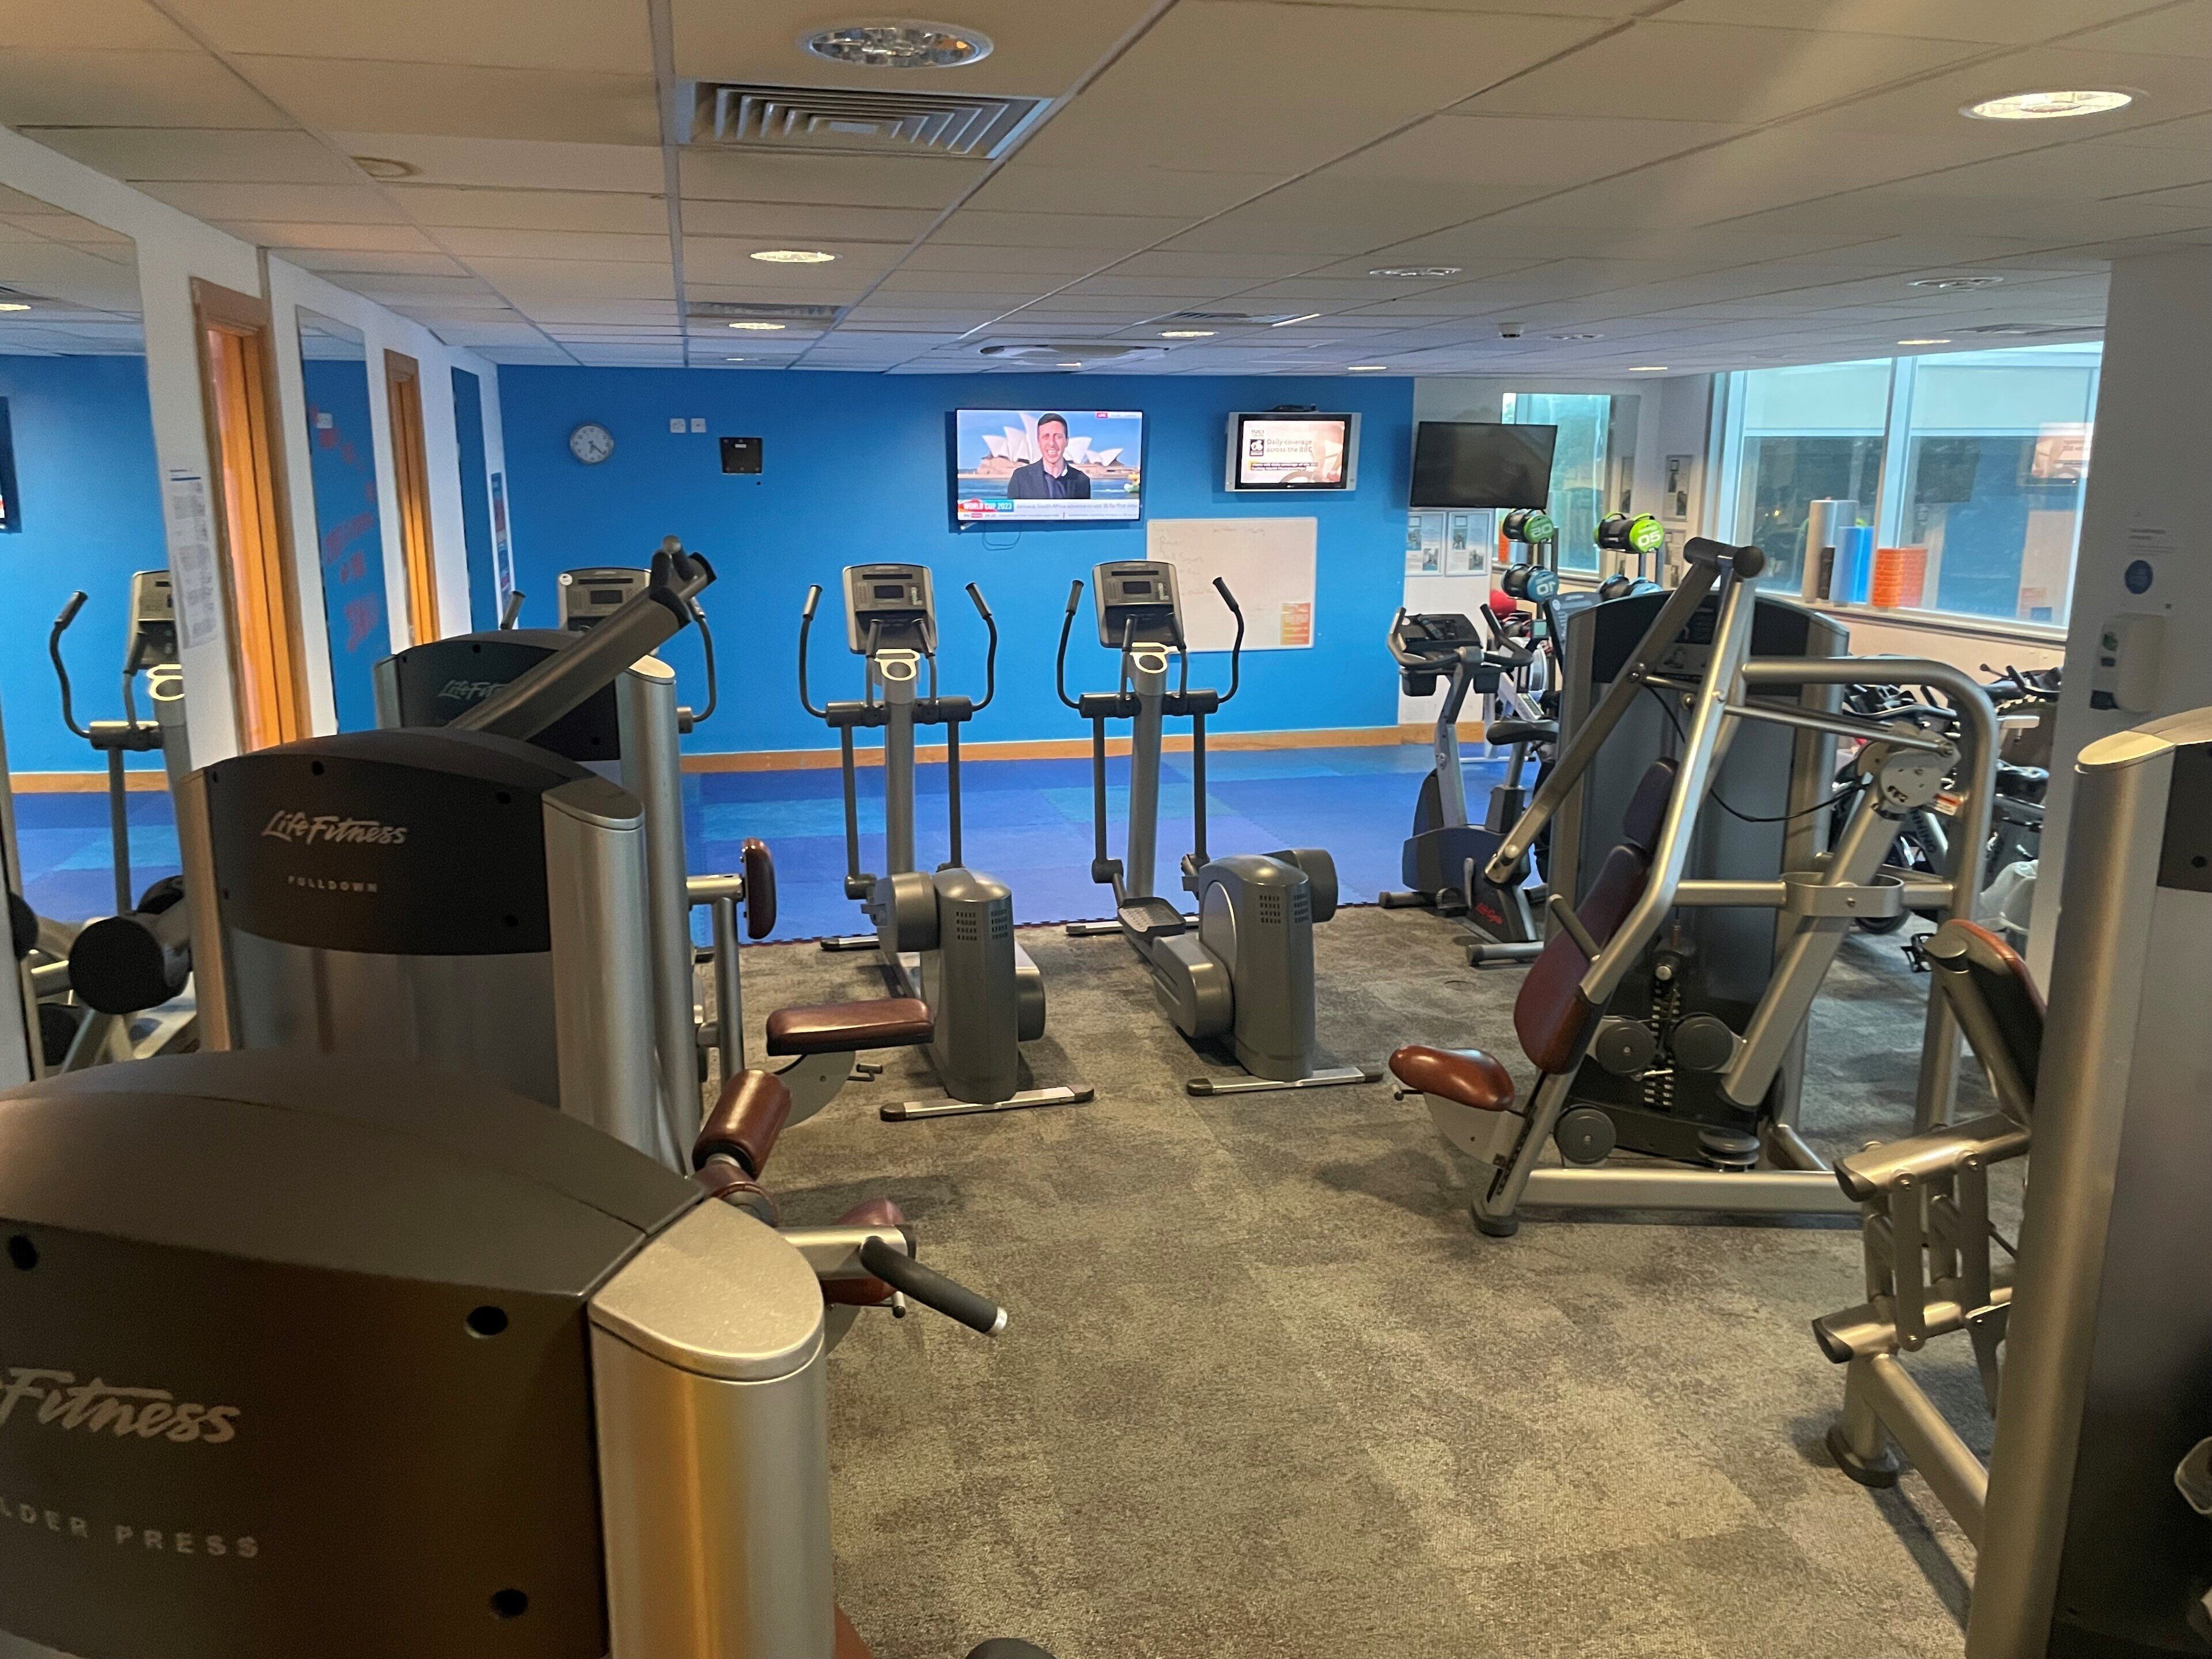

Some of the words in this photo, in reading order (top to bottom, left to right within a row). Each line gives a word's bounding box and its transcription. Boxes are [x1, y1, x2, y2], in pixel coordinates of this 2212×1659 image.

[1638, 531, 1662, 547] 05
[287, 876, 378, 893] PULLDOWN
[115, 1525, 260, 1558] PRESS
